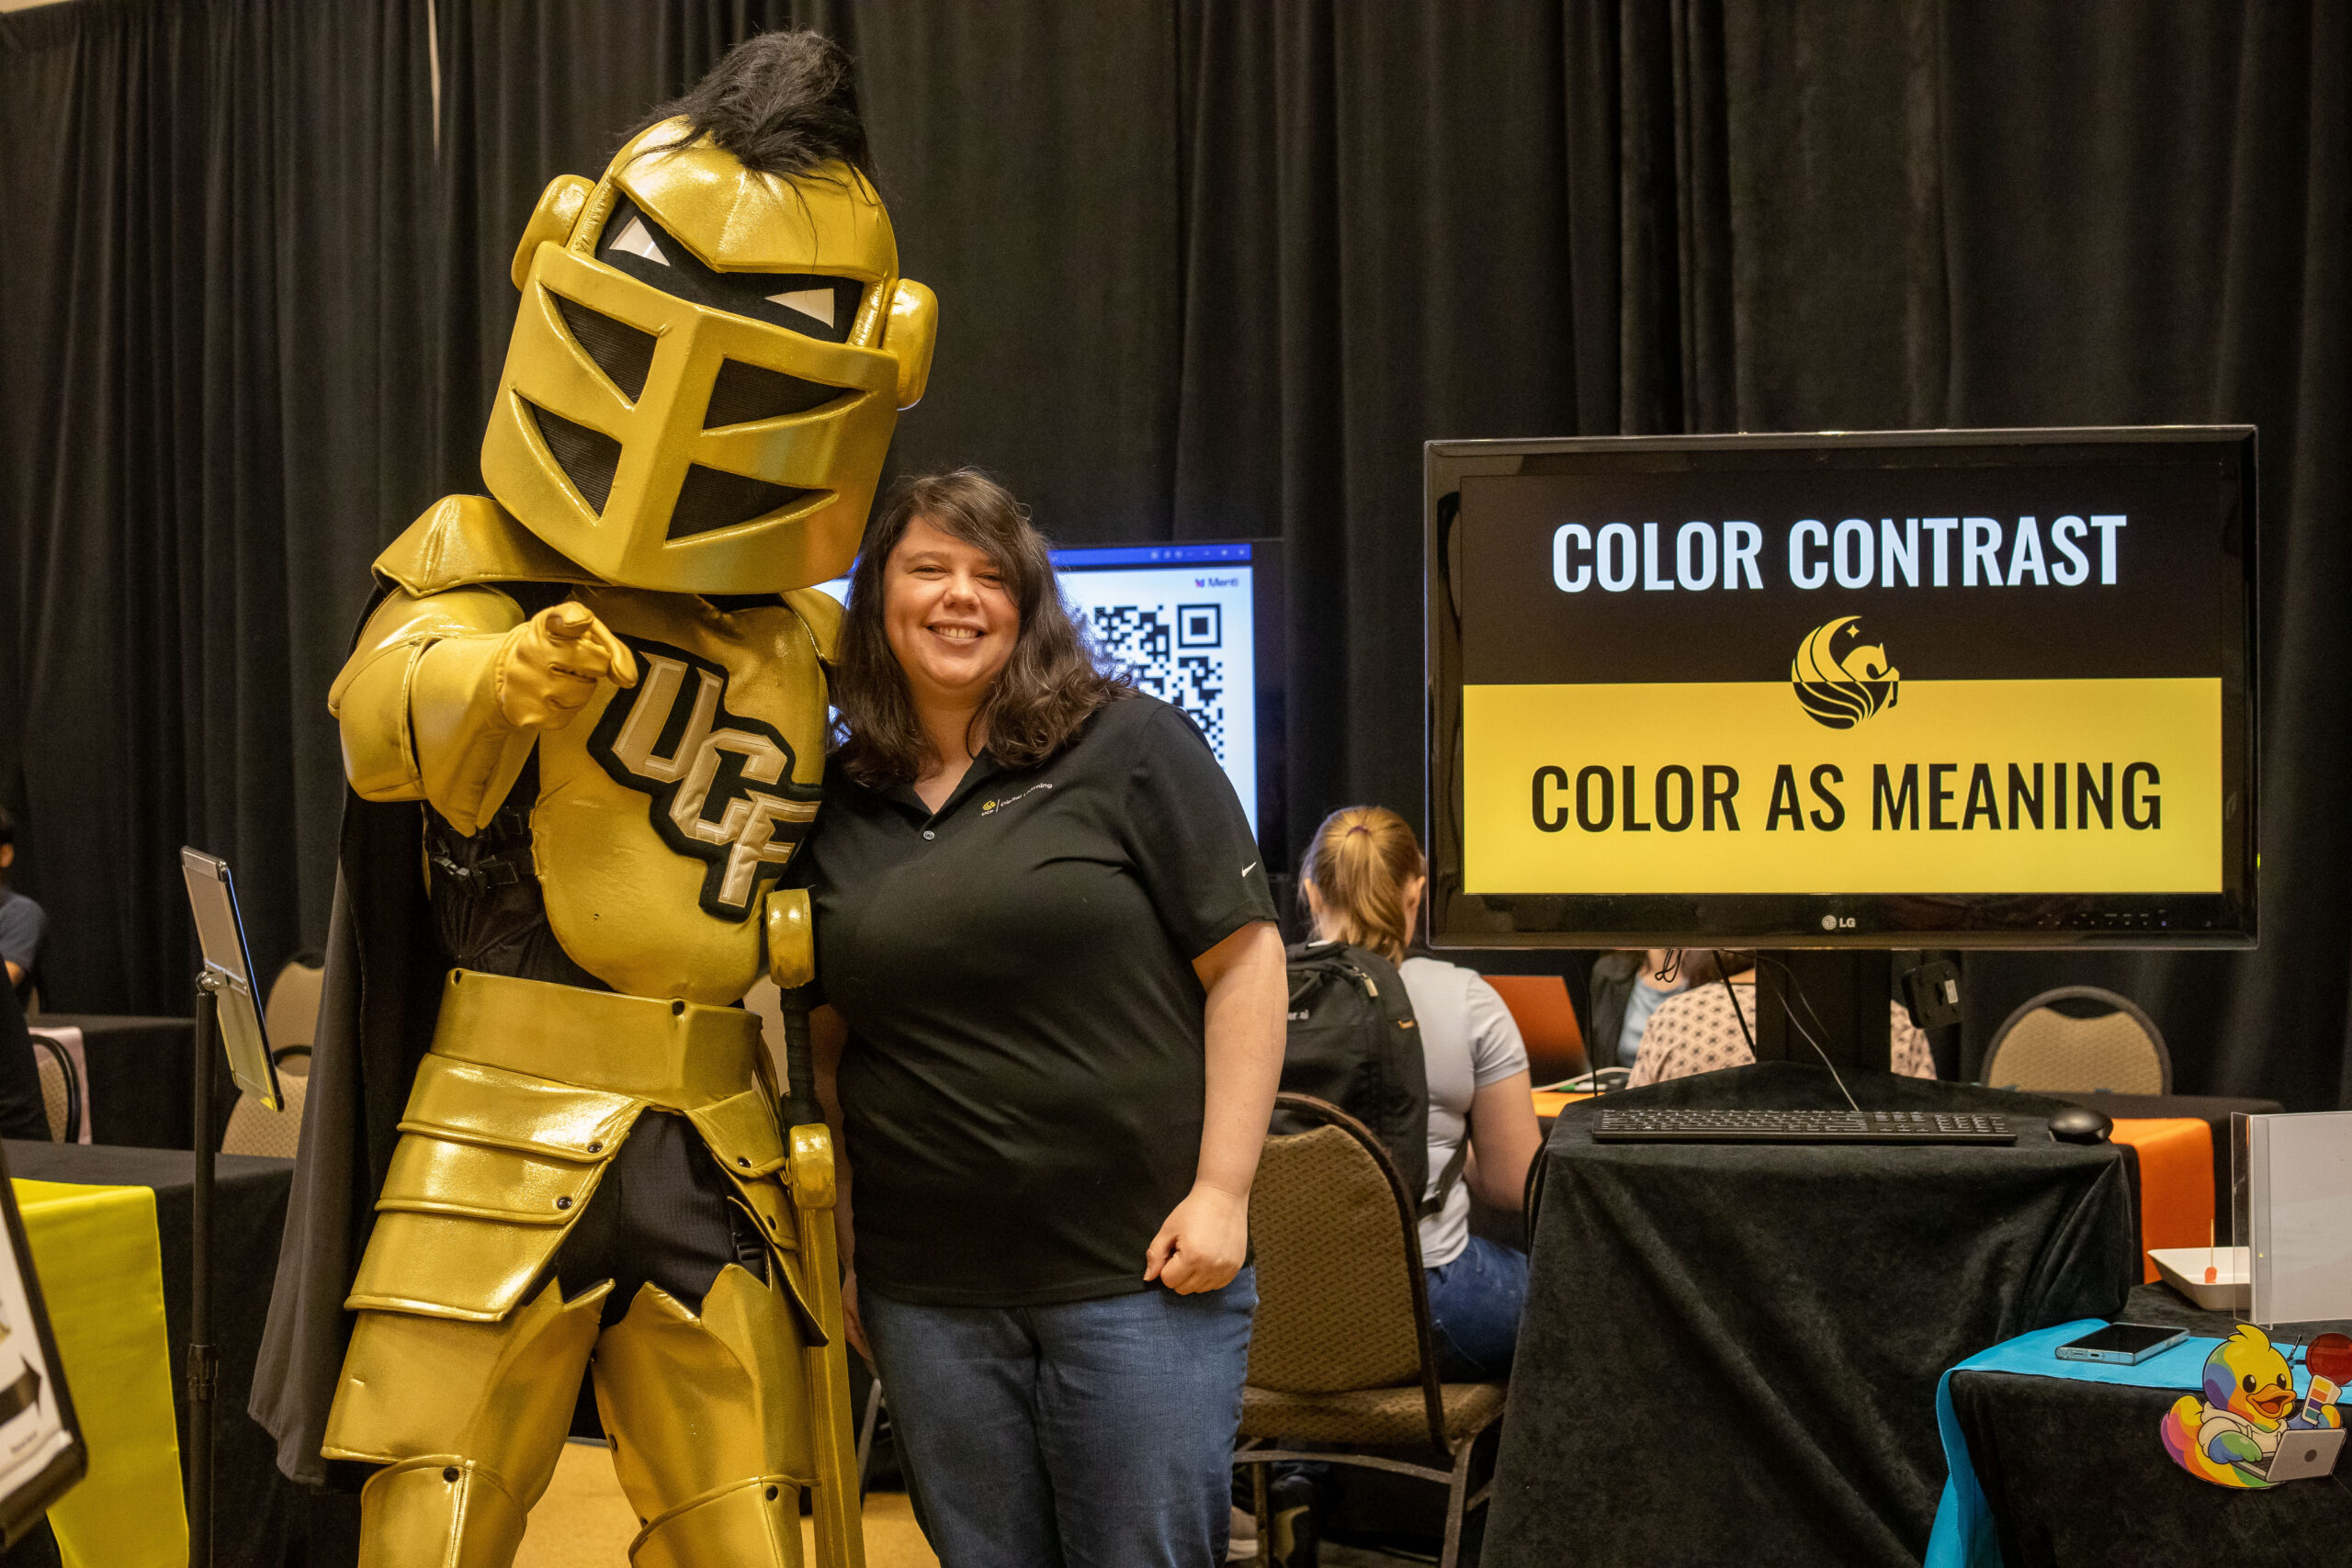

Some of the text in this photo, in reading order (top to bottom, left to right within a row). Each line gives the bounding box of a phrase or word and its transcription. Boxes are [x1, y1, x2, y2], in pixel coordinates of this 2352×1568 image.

[1553, 514, 2128, 593] COLOR CONTRAST
[610, 650, 822, 908] UCF
[1532, 761, 2161, 834] COLOR AS MEANING
[1838, 917, 1856, 928] LG
